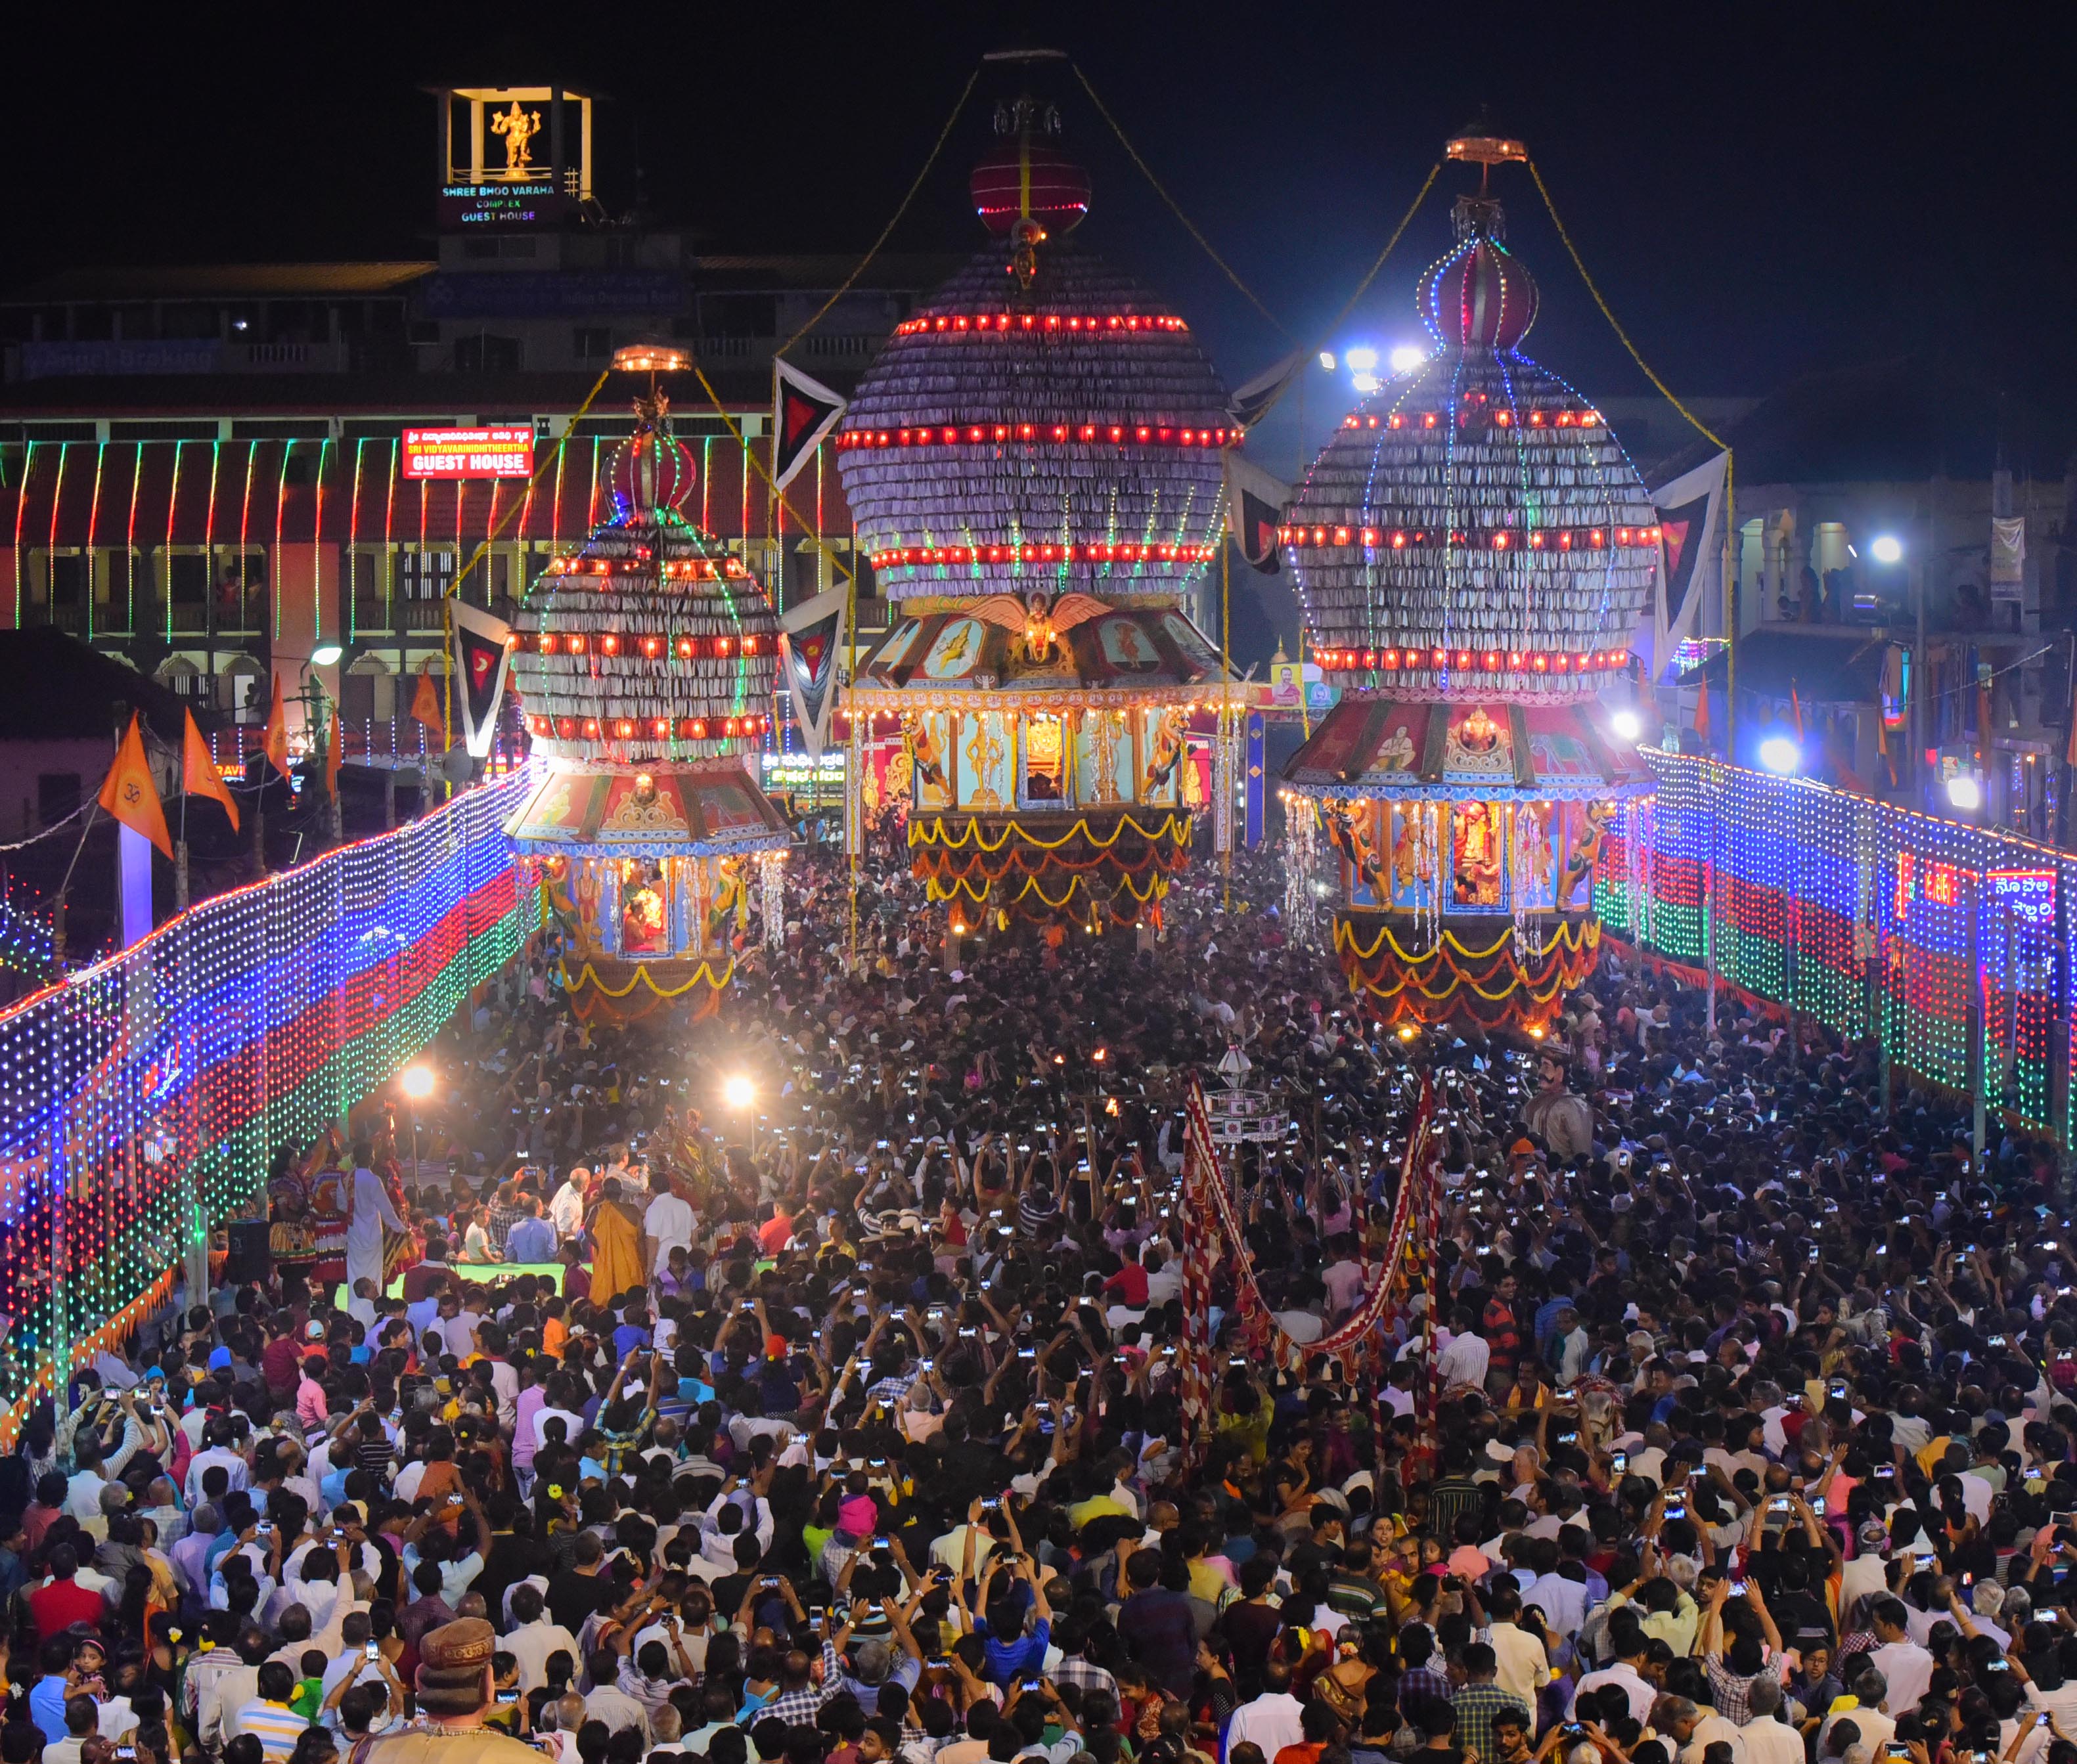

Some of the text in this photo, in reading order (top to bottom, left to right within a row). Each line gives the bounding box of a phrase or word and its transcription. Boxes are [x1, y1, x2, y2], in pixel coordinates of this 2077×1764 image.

[442, 186, 554, 197] SHREE BHOO VARAHA
[462, 211, 535, 222] GUEST HOUSE
[408, 443, 529, 454] SRI VIDYAVARINIDHITHEERTHA
[413, 454, 524, 470] GUEST HOUSE
